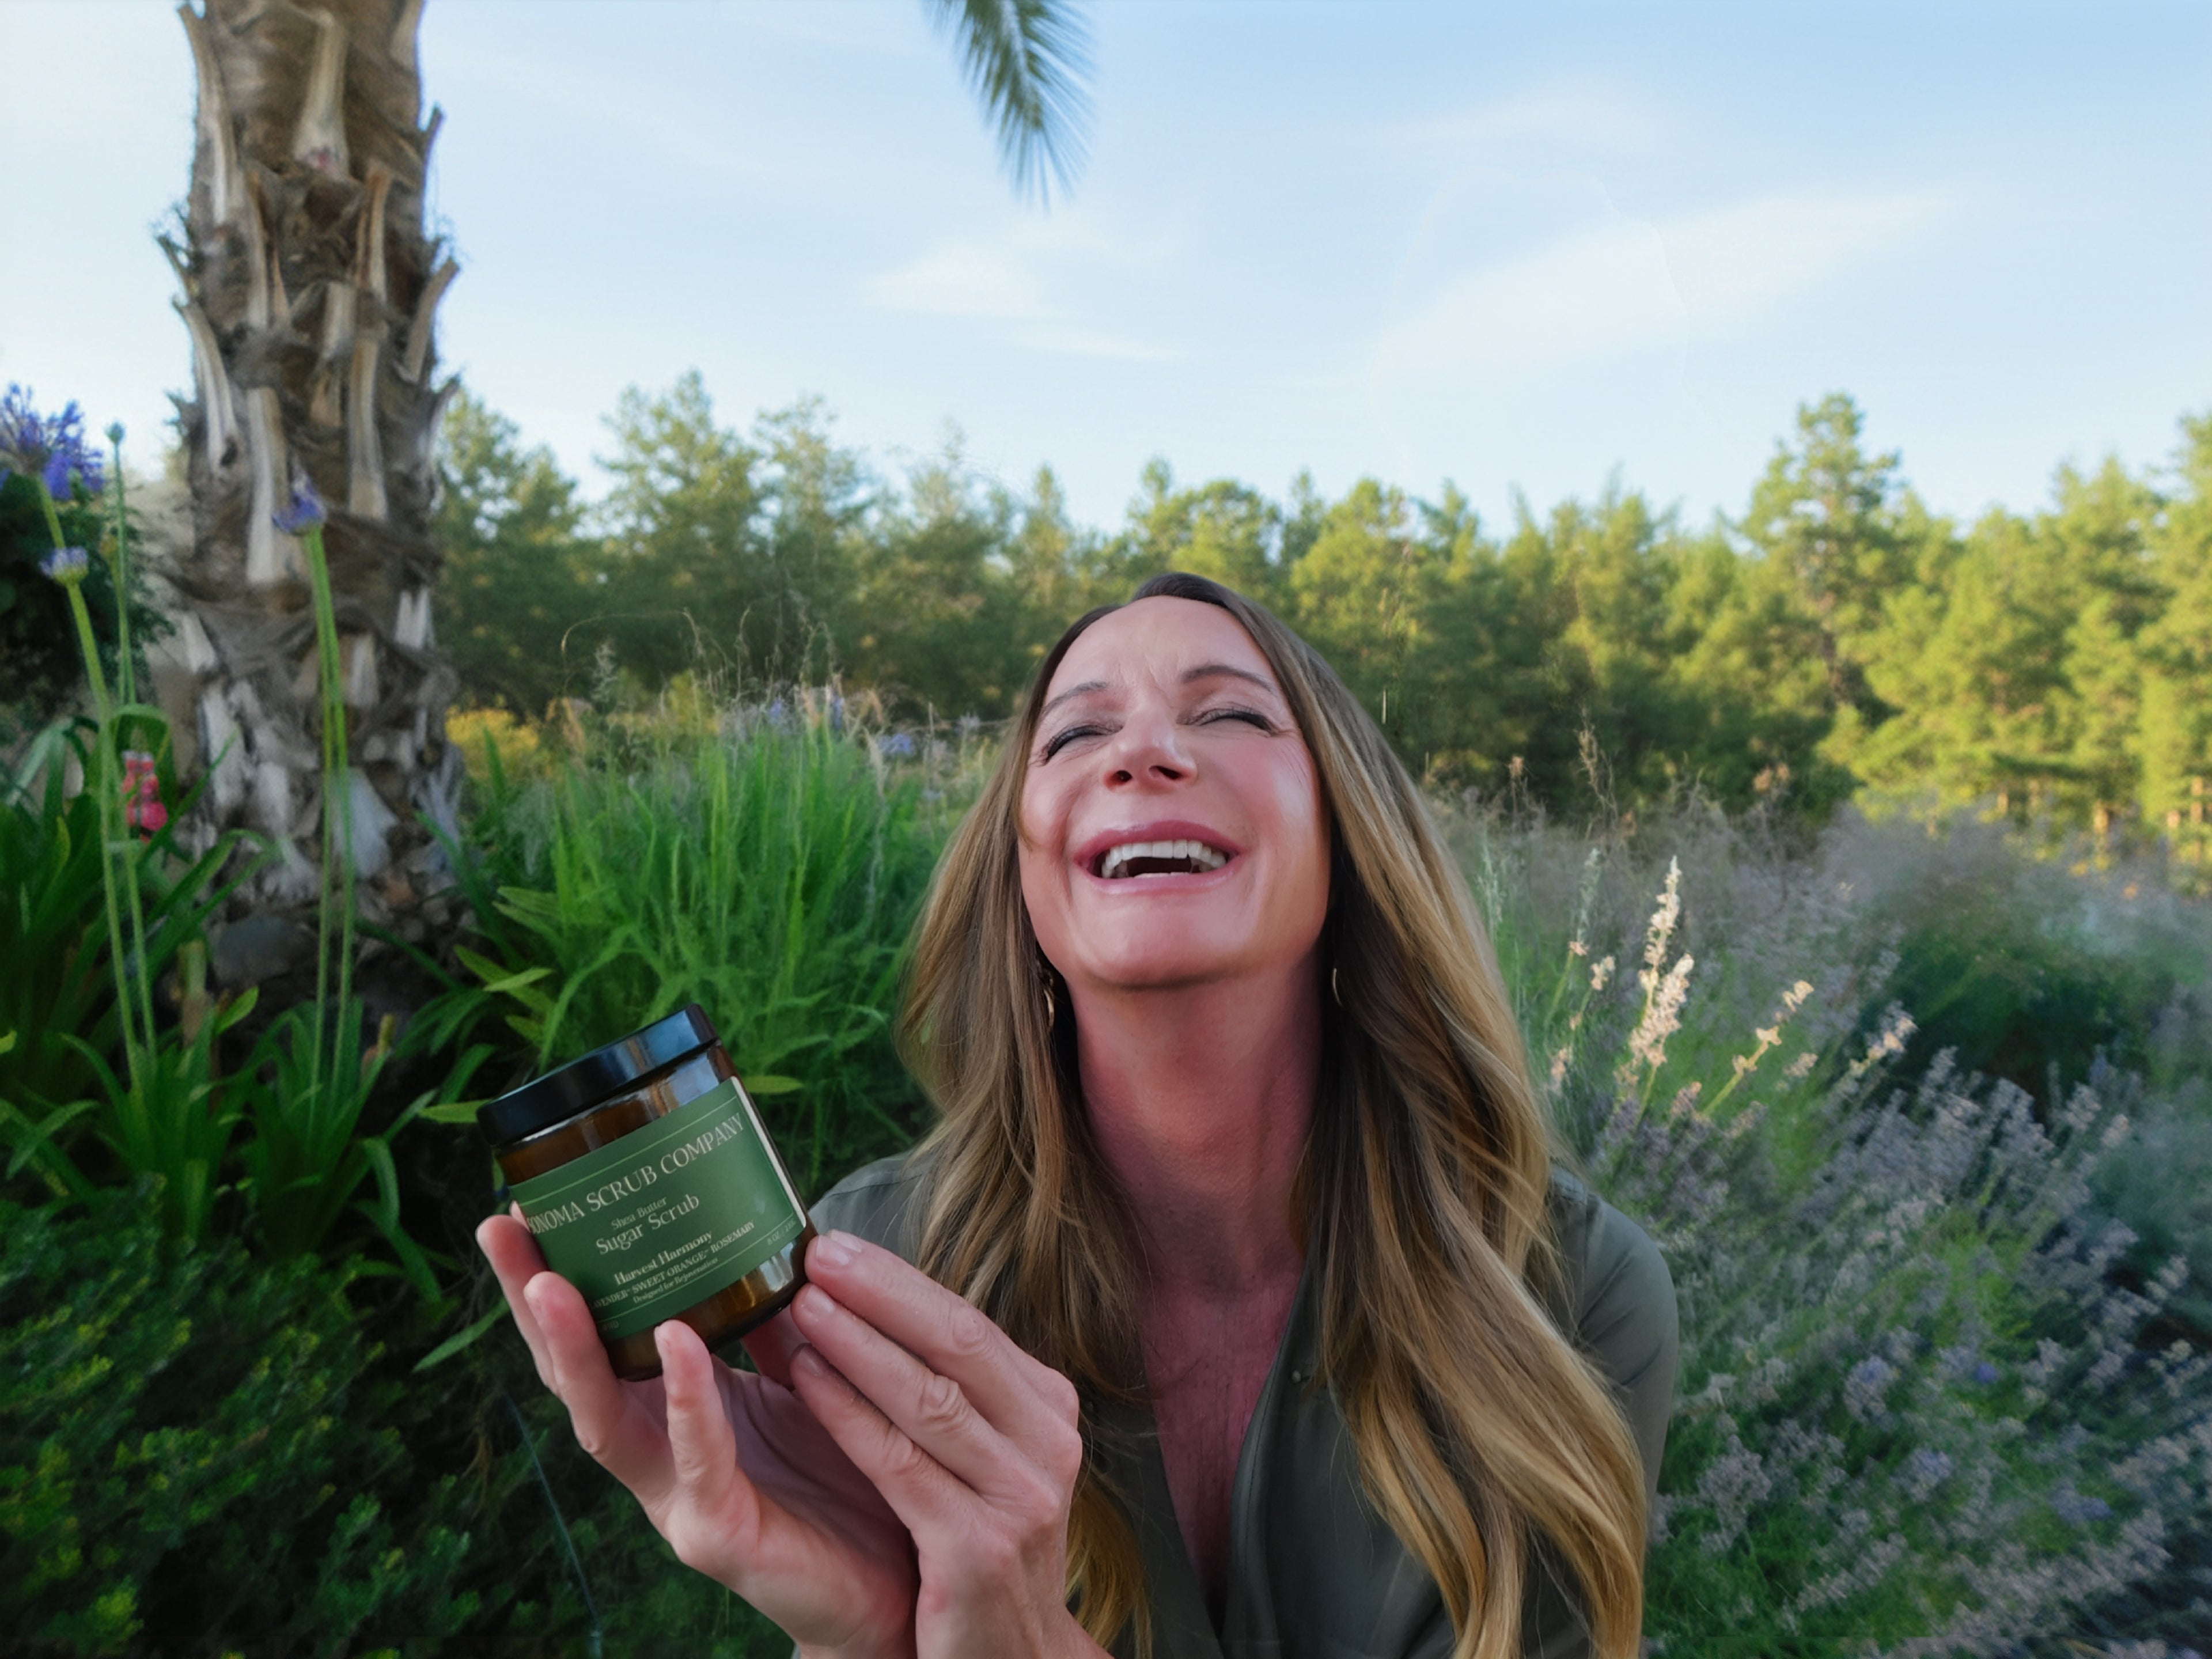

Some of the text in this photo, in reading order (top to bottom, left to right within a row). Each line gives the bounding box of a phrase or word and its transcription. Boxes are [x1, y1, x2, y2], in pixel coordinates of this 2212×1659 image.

[586, 1165, 657, 1211] SCRUB
[660, 1112, 744, 1175] COMPANY
[596, 1193, 699, 1255] Sugar Scrub
[611, 1196, 666, 1230] Shea Butter
[613, 1230, 713, 1286] Harvest Harmony
[632, 1271, 666, 1294] SWEET
[710, 1219, 755, 1254] ROSEMARY
[664, 1280, 675, 1290] for
